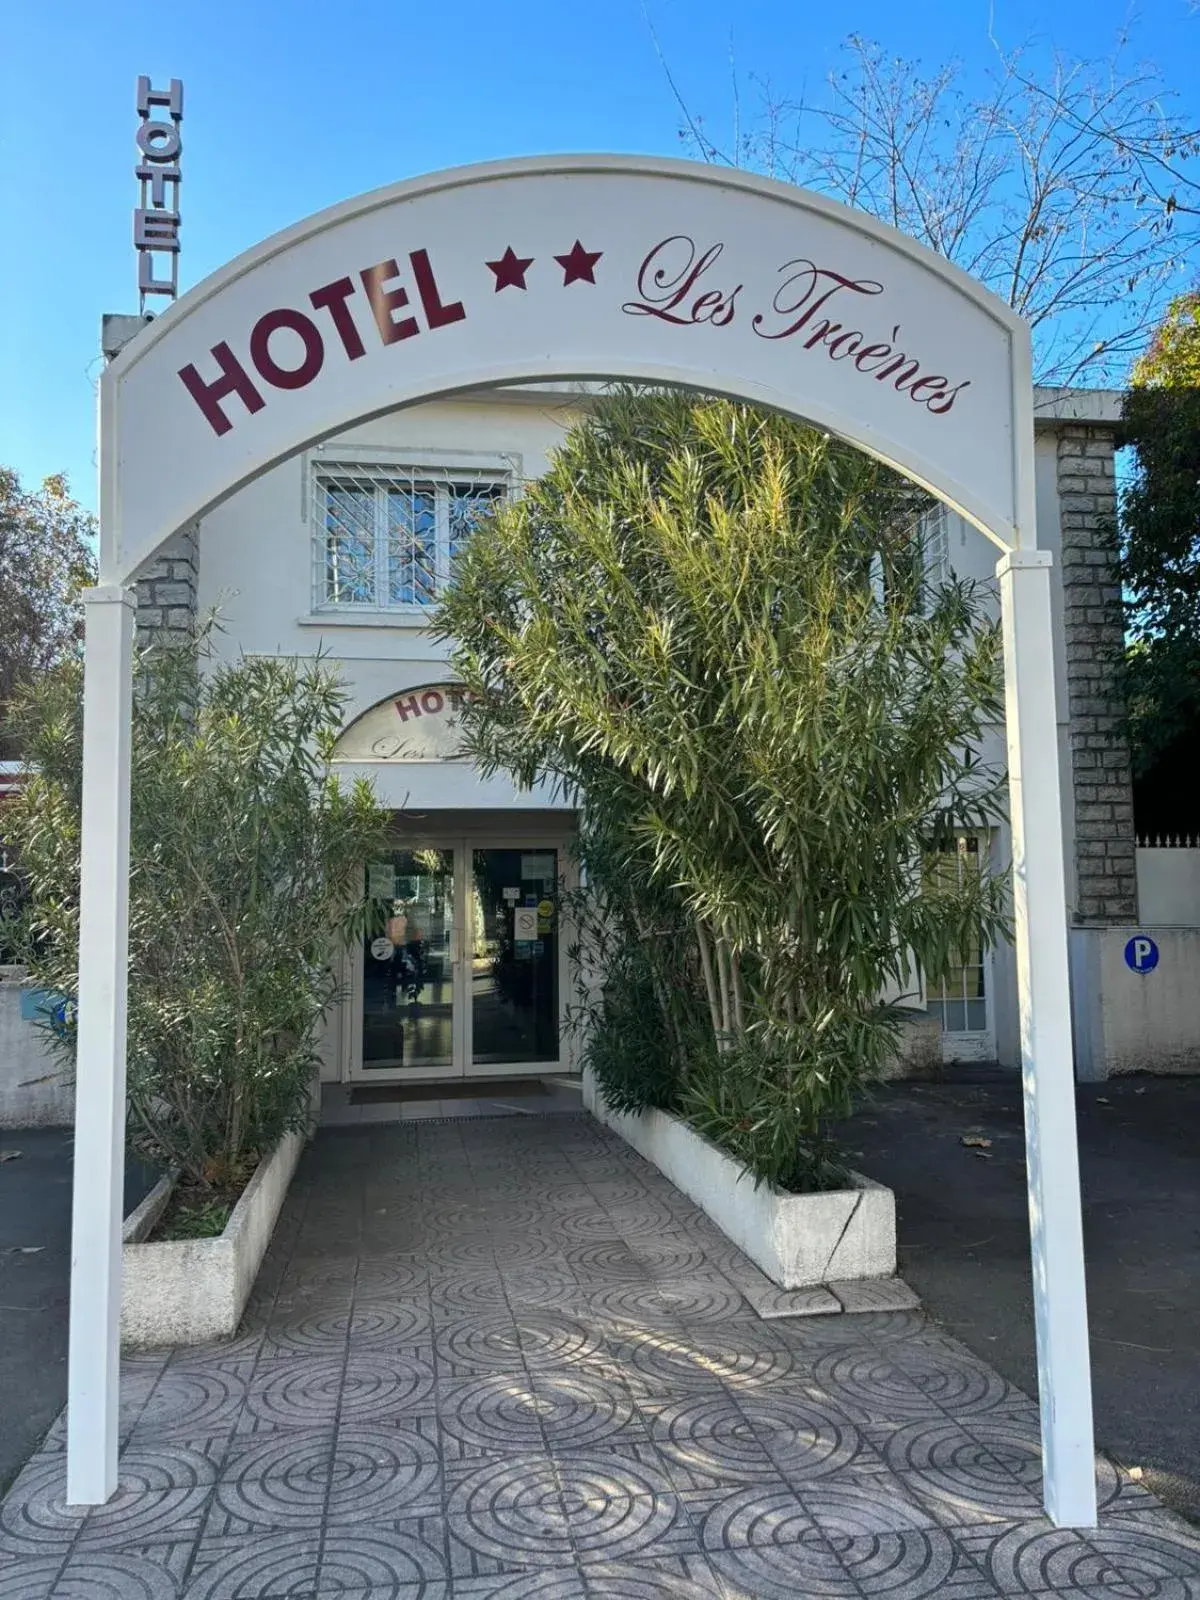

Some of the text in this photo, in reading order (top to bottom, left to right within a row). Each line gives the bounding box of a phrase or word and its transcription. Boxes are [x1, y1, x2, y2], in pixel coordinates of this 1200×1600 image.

[134, 75, 183, 295] HOTEL
[177, 235, 971, 437] HOTEL Les Troènes
[395, 688, 482, 722] HOT
[369, 735, 425, 760] Les
[1135, 940, 1151, 967] P
